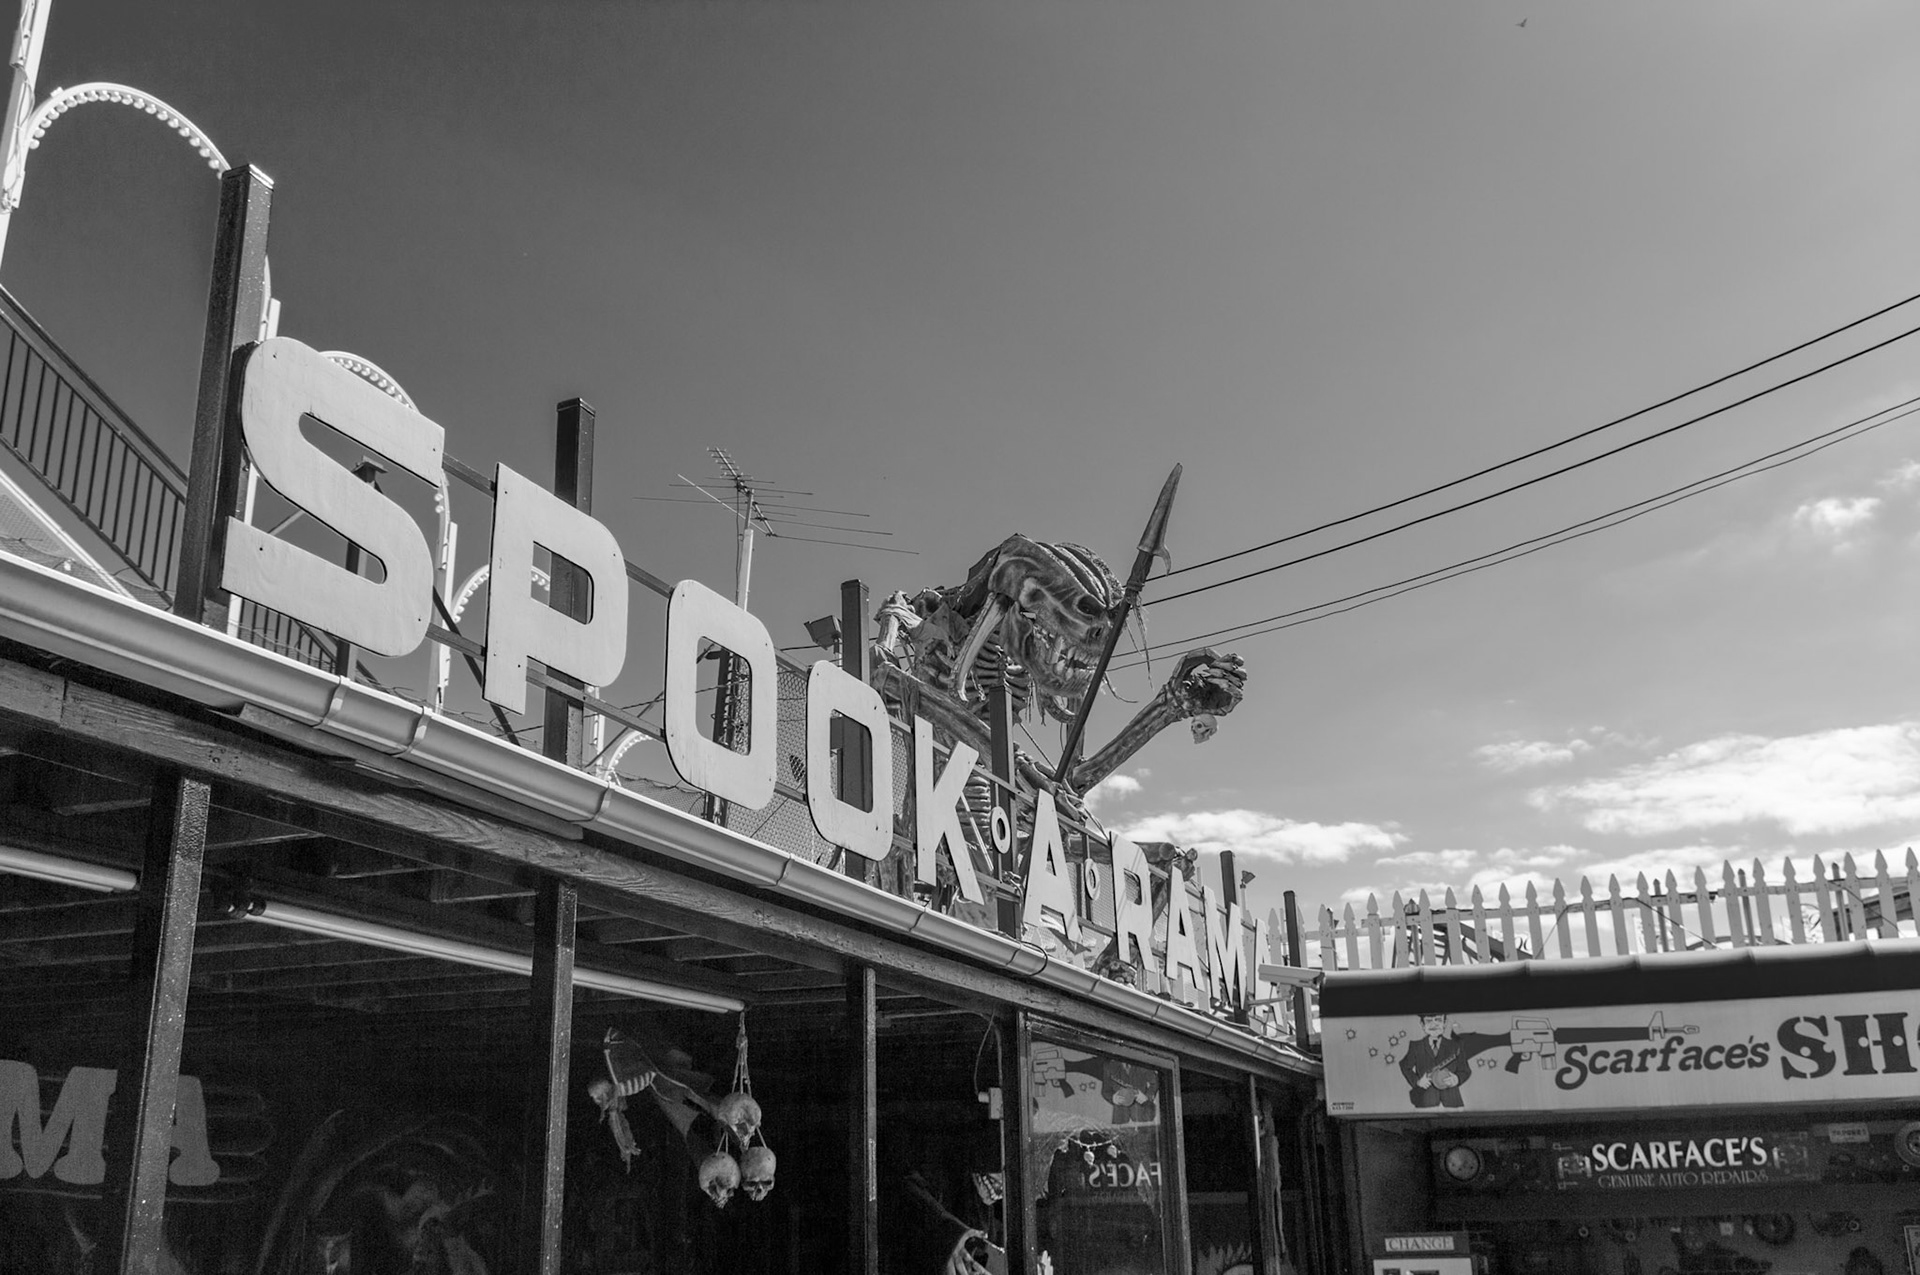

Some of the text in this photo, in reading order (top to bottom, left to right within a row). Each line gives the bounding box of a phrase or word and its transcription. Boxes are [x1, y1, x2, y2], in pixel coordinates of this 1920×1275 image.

[1555, 1012, 1920, 1090] Scarface's SH
[1592, 1137, 1768, 1172] SCARFACE'S
[1598, 1172, 1655, 1189] GENUINE
[1659, 1171, 1698, 1187] AUTO
[1388, 1237, 1451, 1250] CHANGE
